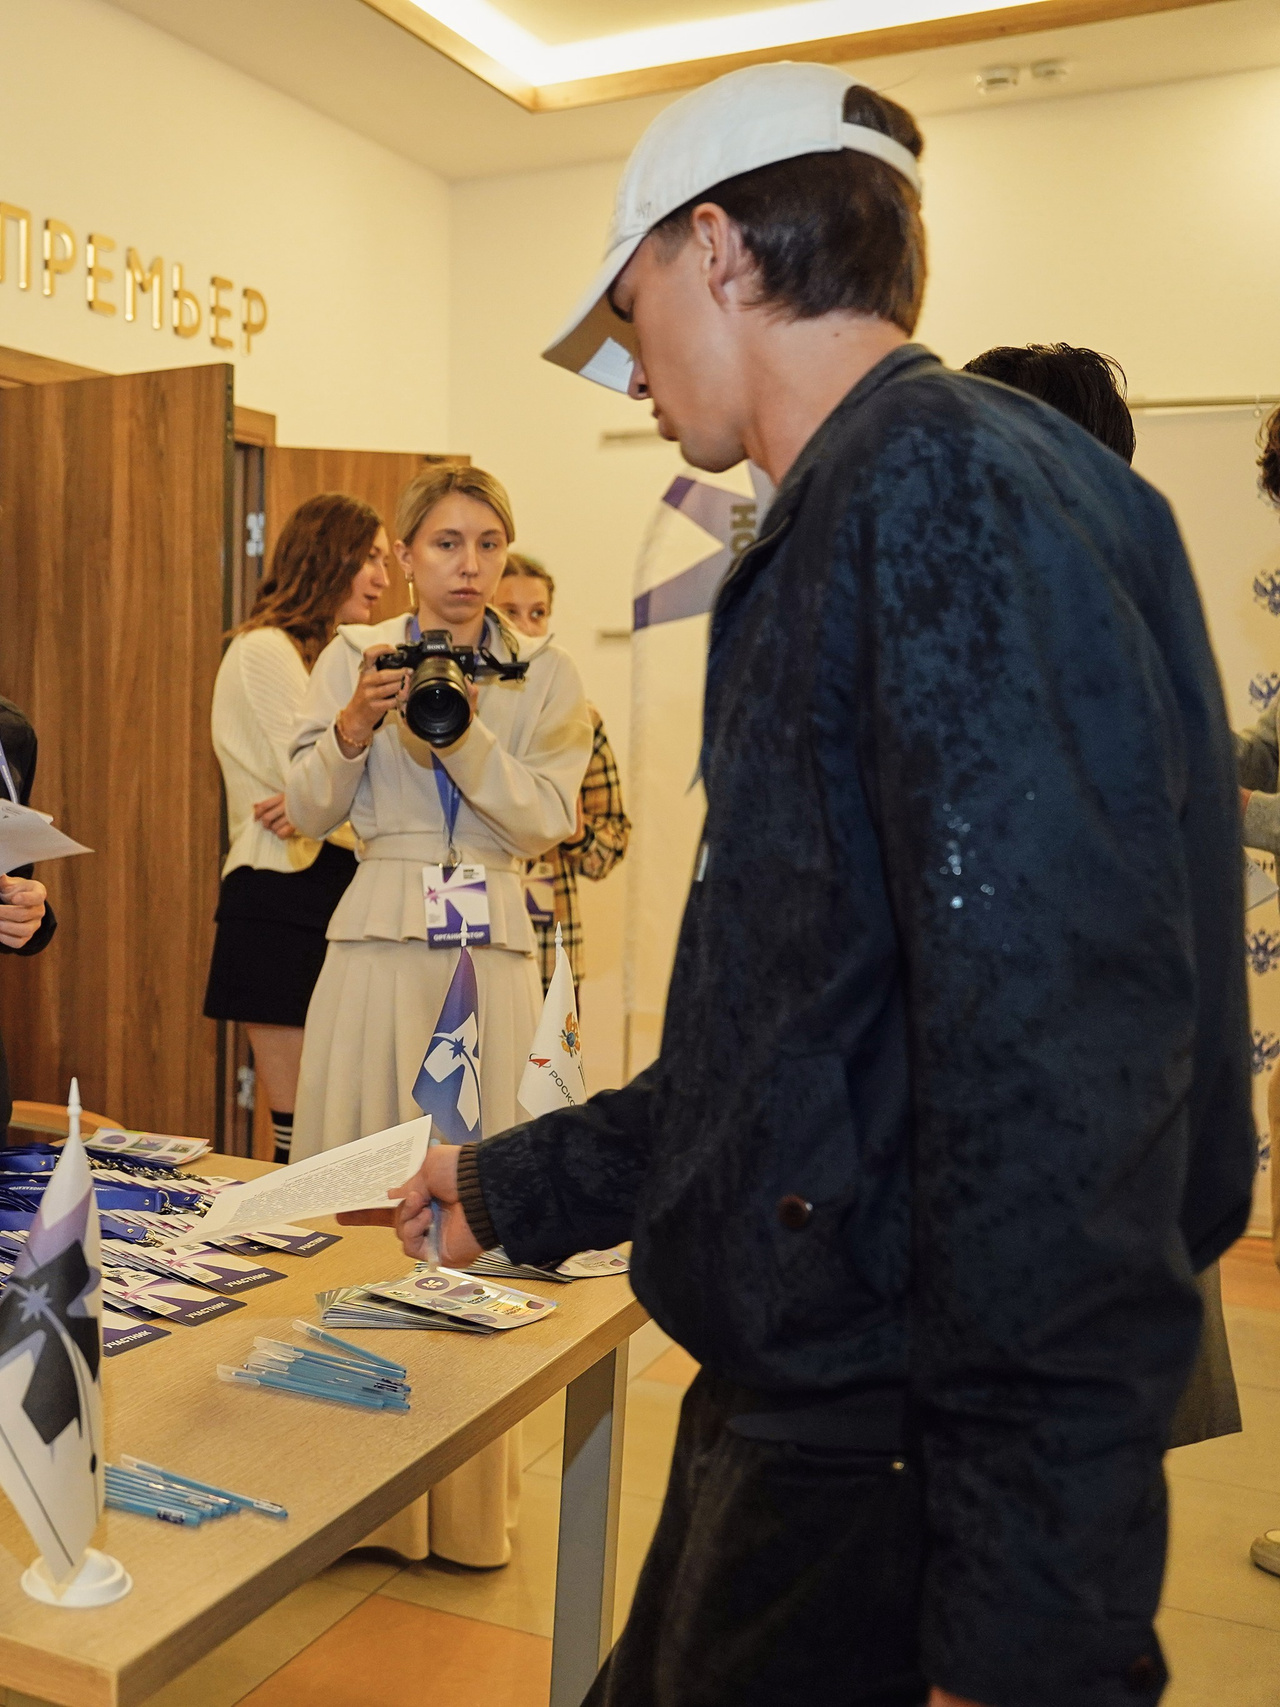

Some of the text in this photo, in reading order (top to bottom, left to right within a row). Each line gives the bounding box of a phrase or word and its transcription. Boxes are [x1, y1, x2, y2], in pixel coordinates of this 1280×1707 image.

[549, 1070, 576, 1106] РОСКО
[185, 1301, 229, 1319] УЧАСТНИК
[103, 1330, 152, 1349] УЧАСТНИК
